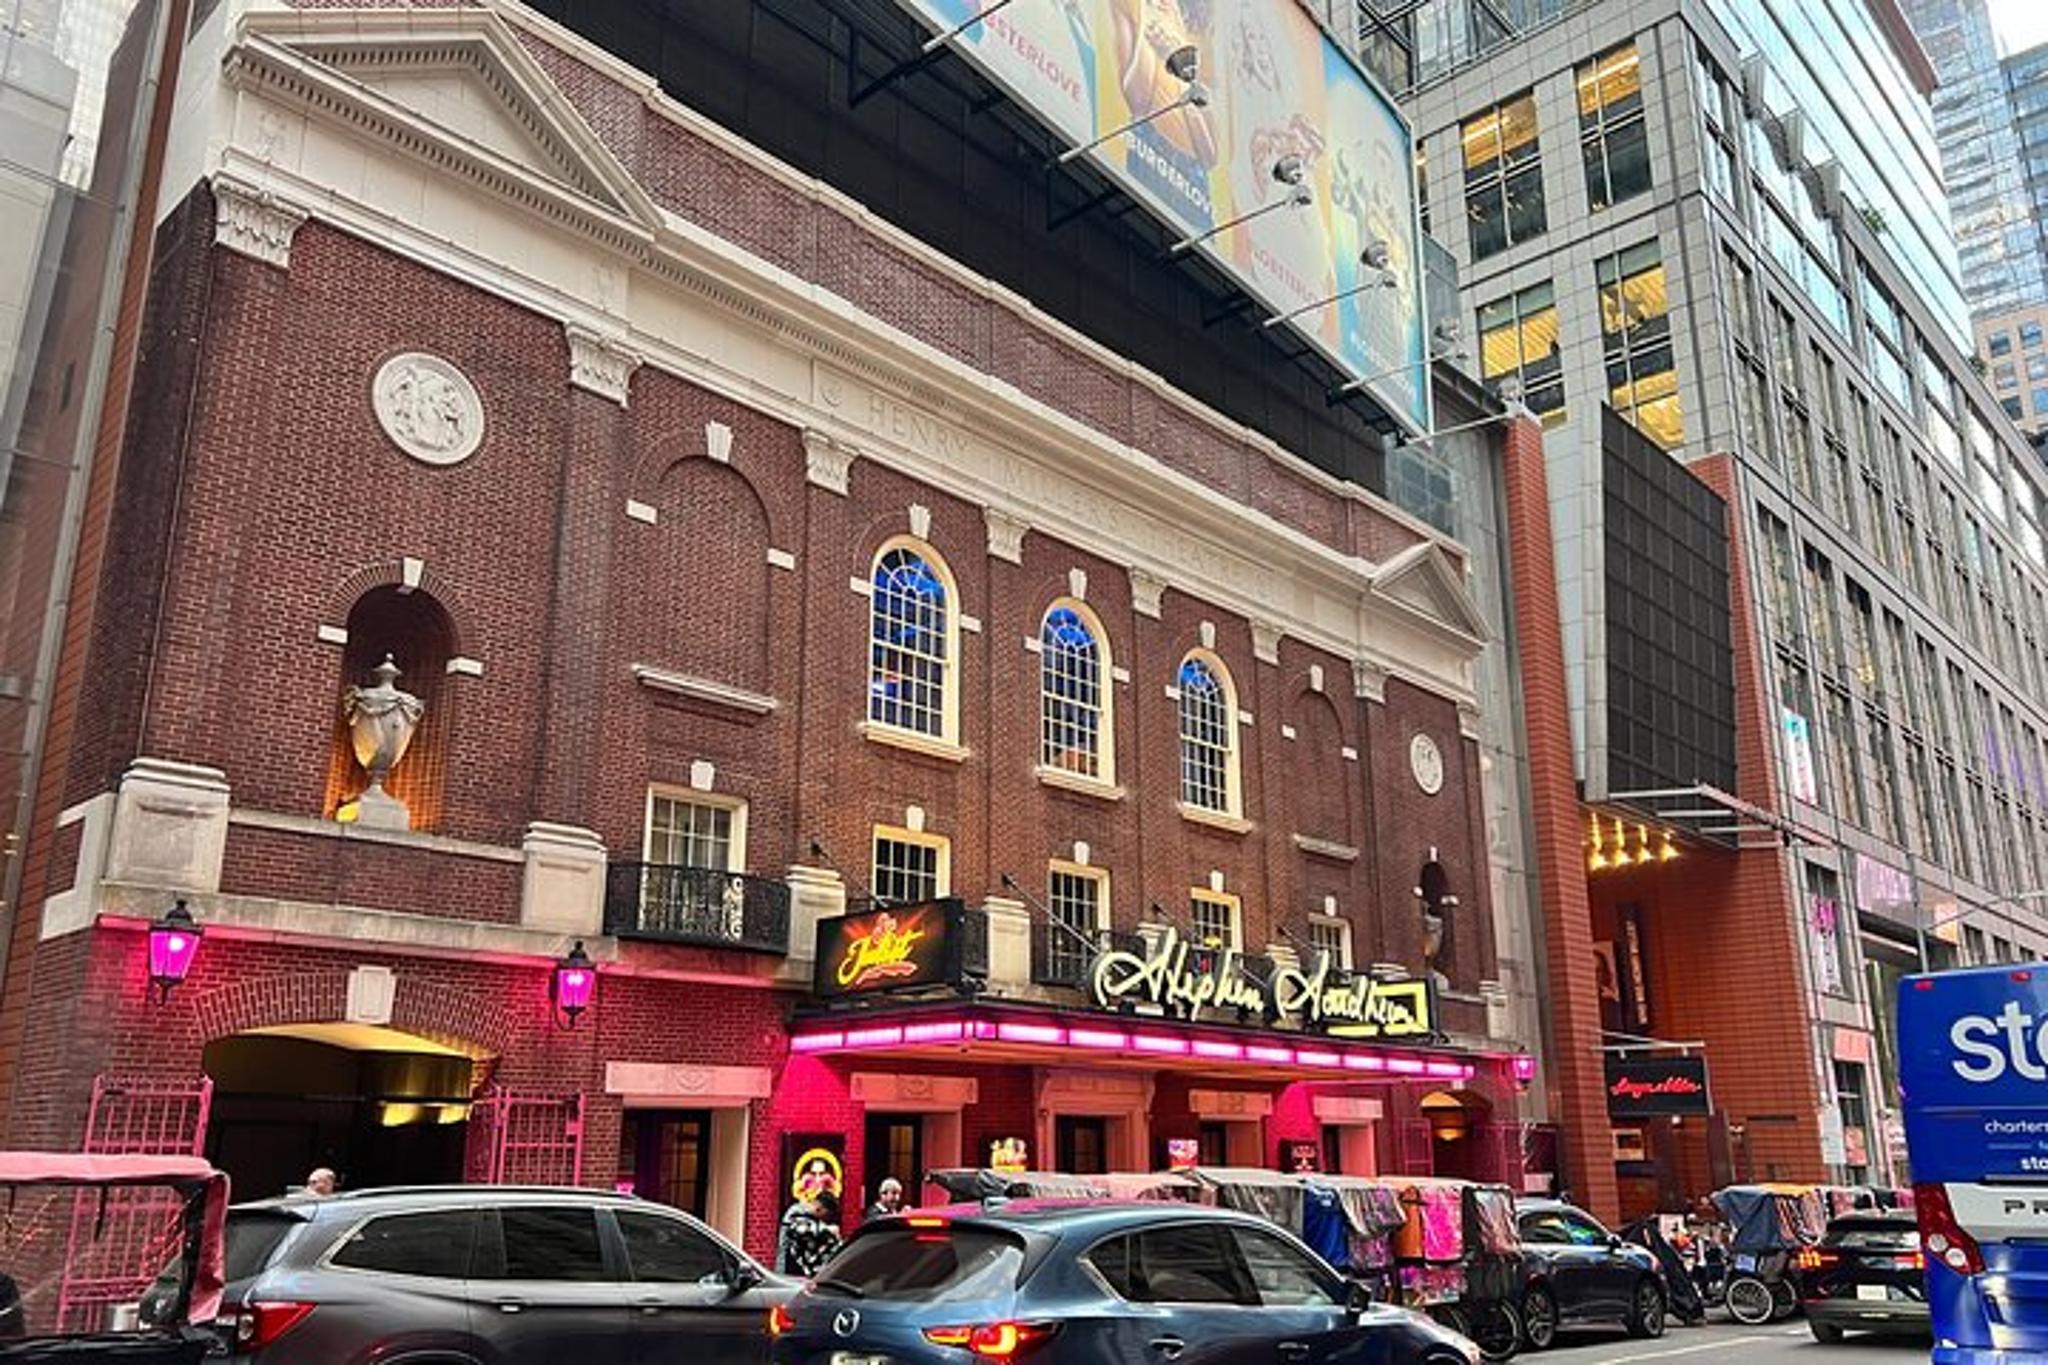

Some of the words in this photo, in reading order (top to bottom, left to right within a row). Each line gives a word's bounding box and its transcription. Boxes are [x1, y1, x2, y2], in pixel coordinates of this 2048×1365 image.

[868, 393, 969, 455] HENRY
[1094, 927, 1264, 1022] Stephen
[1274, 950, 1414, 1021] Sondheim
